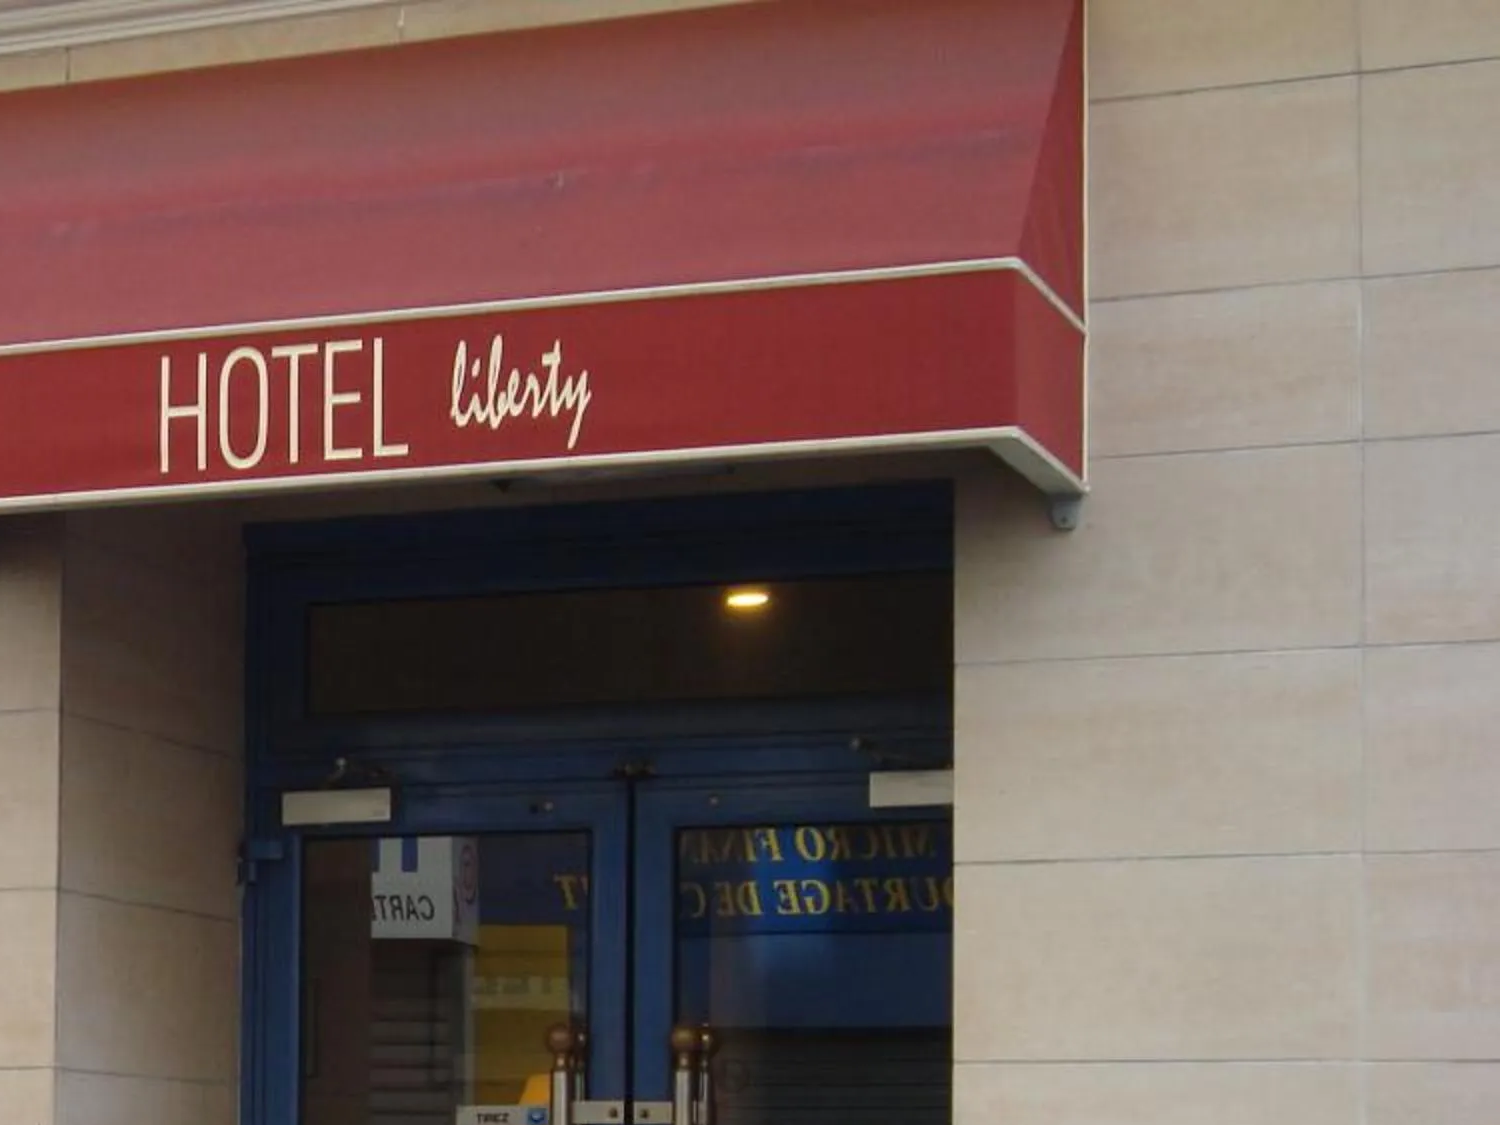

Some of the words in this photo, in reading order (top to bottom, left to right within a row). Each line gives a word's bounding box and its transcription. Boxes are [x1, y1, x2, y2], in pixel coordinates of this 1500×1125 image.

[159, 337, 409, 473] HOTEL
[450, 333, 592, 450] liberty
[476, 1112, 511, 1124] TIREZ
